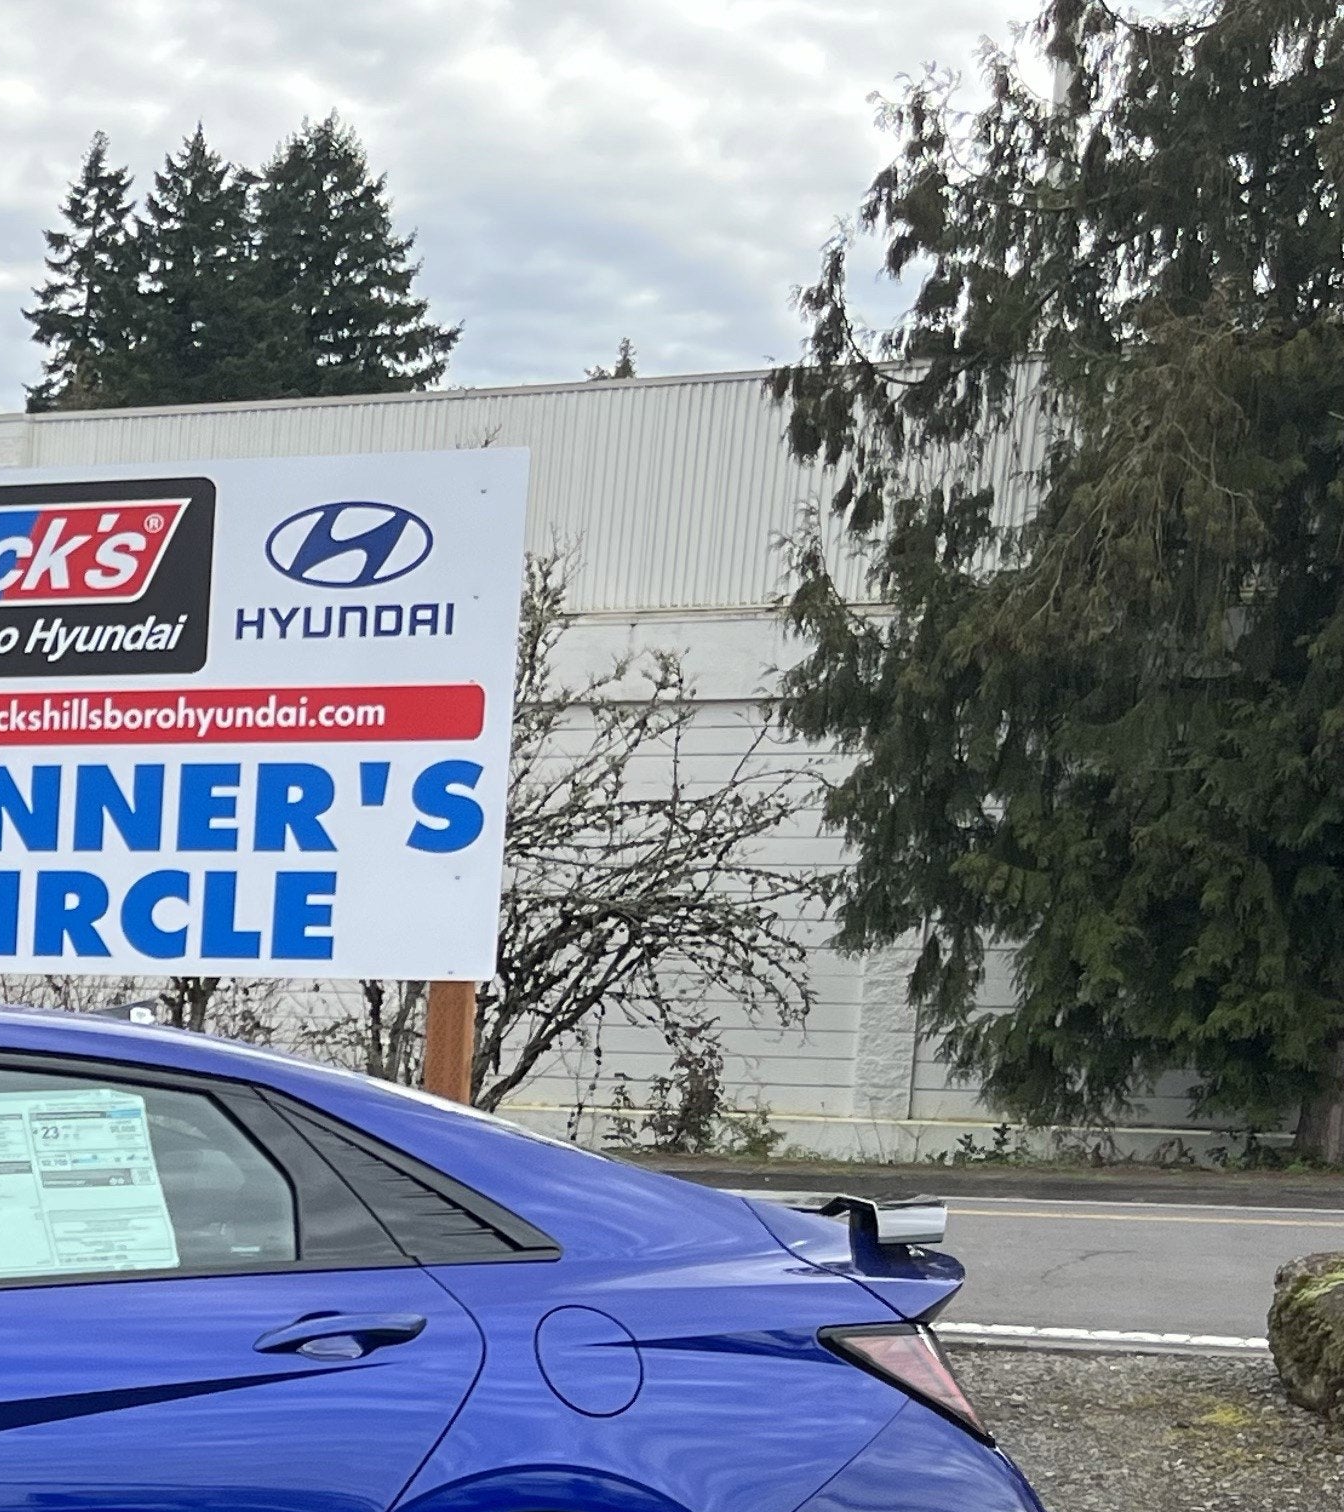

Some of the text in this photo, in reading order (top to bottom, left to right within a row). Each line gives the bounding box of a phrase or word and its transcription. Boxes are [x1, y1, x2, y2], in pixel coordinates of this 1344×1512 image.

[24, 614, 189, 662] Hyundai
[235, 602, 454, 640] HYUNDAI
[41, 1126, 59, 1140] 23
